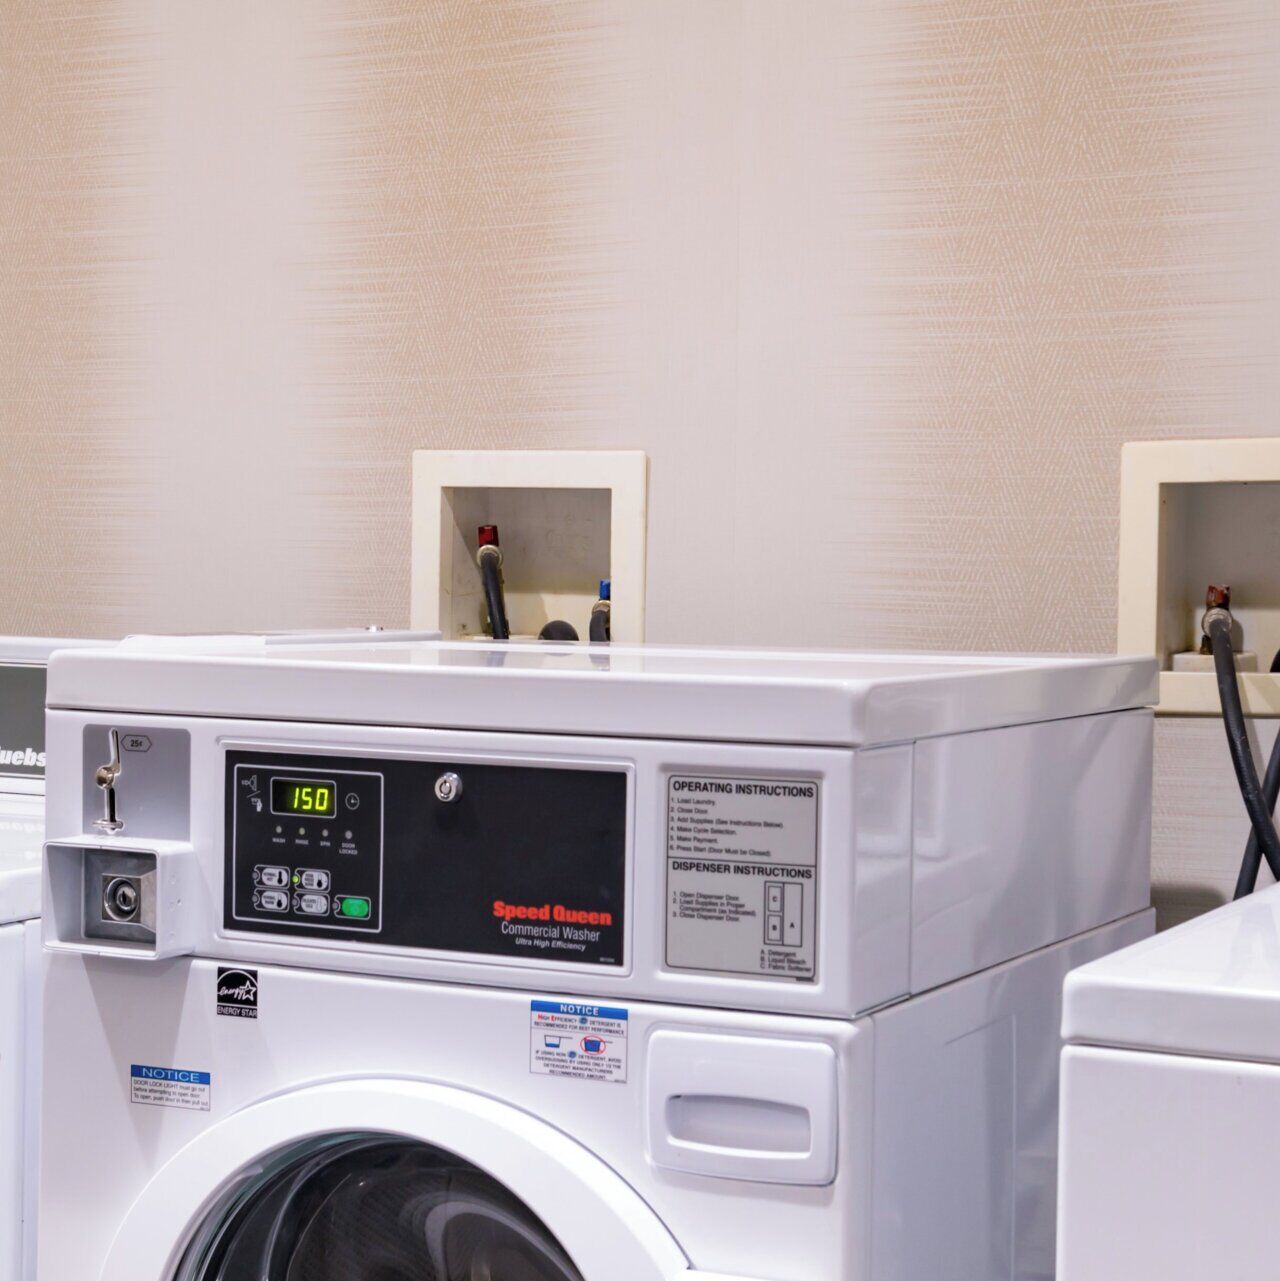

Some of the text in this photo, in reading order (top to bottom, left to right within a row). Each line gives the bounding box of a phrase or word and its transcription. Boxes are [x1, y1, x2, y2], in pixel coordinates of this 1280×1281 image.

[673, 780, 814, 798] OPERATING INSTRUCTIONS
[293, 787, 329, 811] 150
[672, 860, 813, 879] DISPENSER INSTRUCTIONS
[493, 900, 613, 926] Speed Queen
[501, 920, 601, 942] Commercial Washer
[515, 937, 587, 952] Ultra High Efficiency
[217, 1006, 257, 1017] ENERGY STAR
[560, 1004, 599, 1016] NOTICE
[142, 1067, 200, 1083] NOTICE
